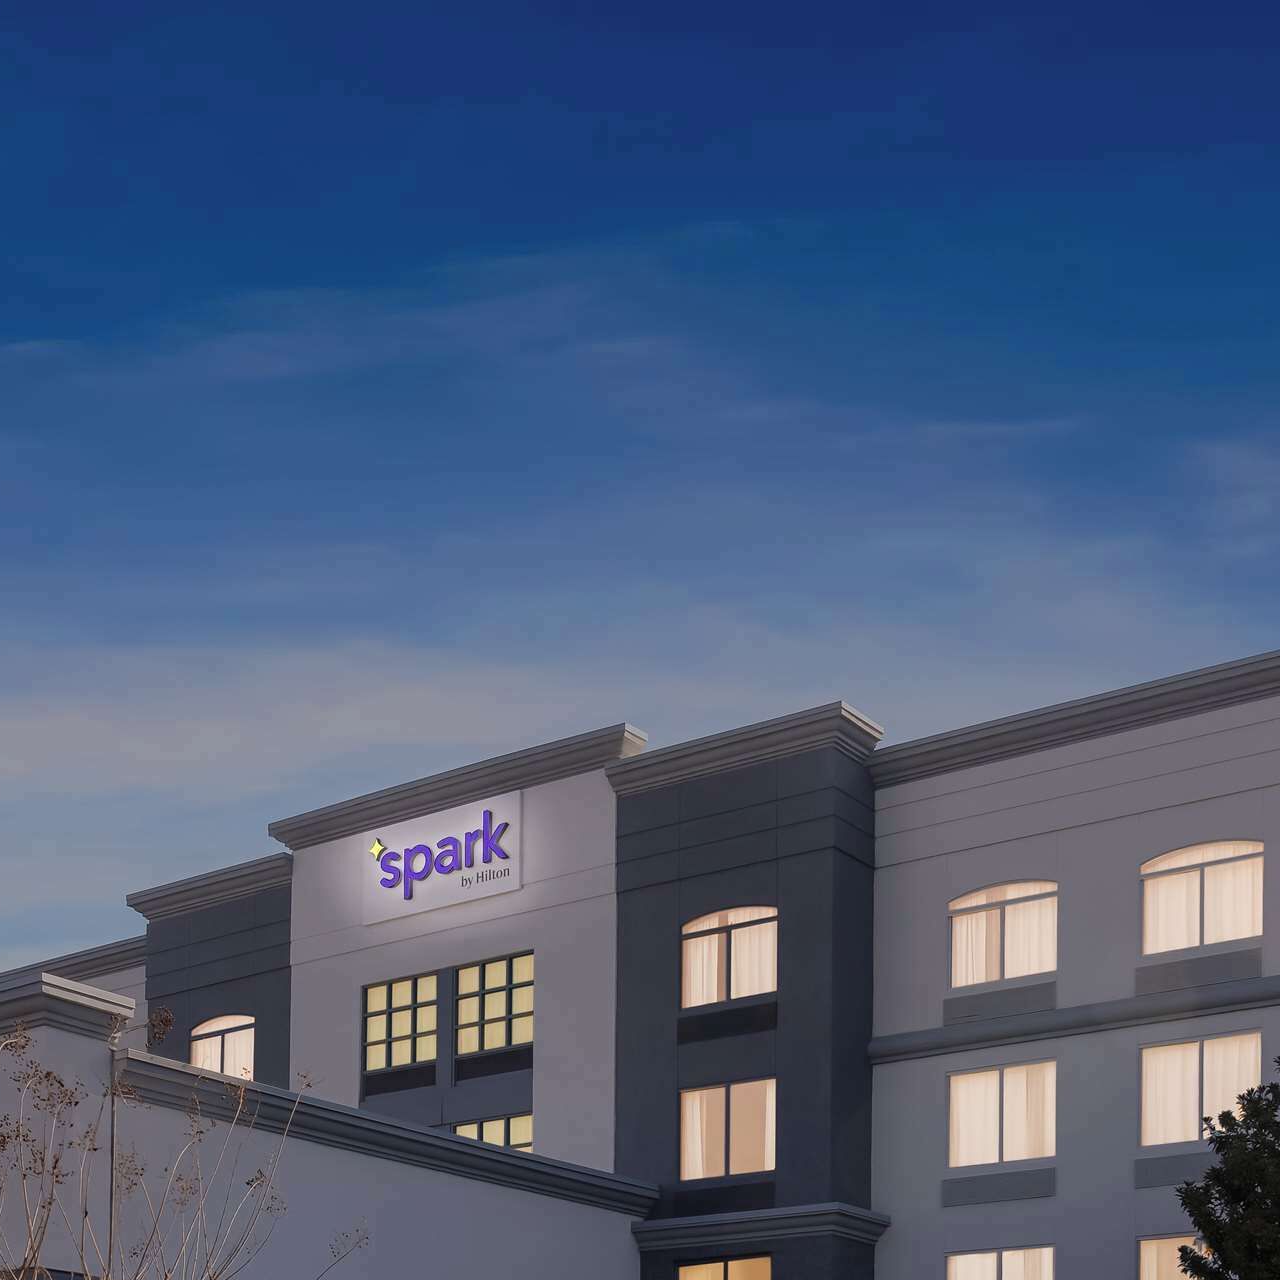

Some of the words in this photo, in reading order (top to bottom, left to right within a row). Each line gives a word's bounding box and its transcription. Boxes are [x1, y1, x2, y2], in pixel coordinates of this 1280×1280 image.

[380, 810, 510, 900] spark
[461, 876, 473, 888] by
[476, 867, 510, 884] Hilton
